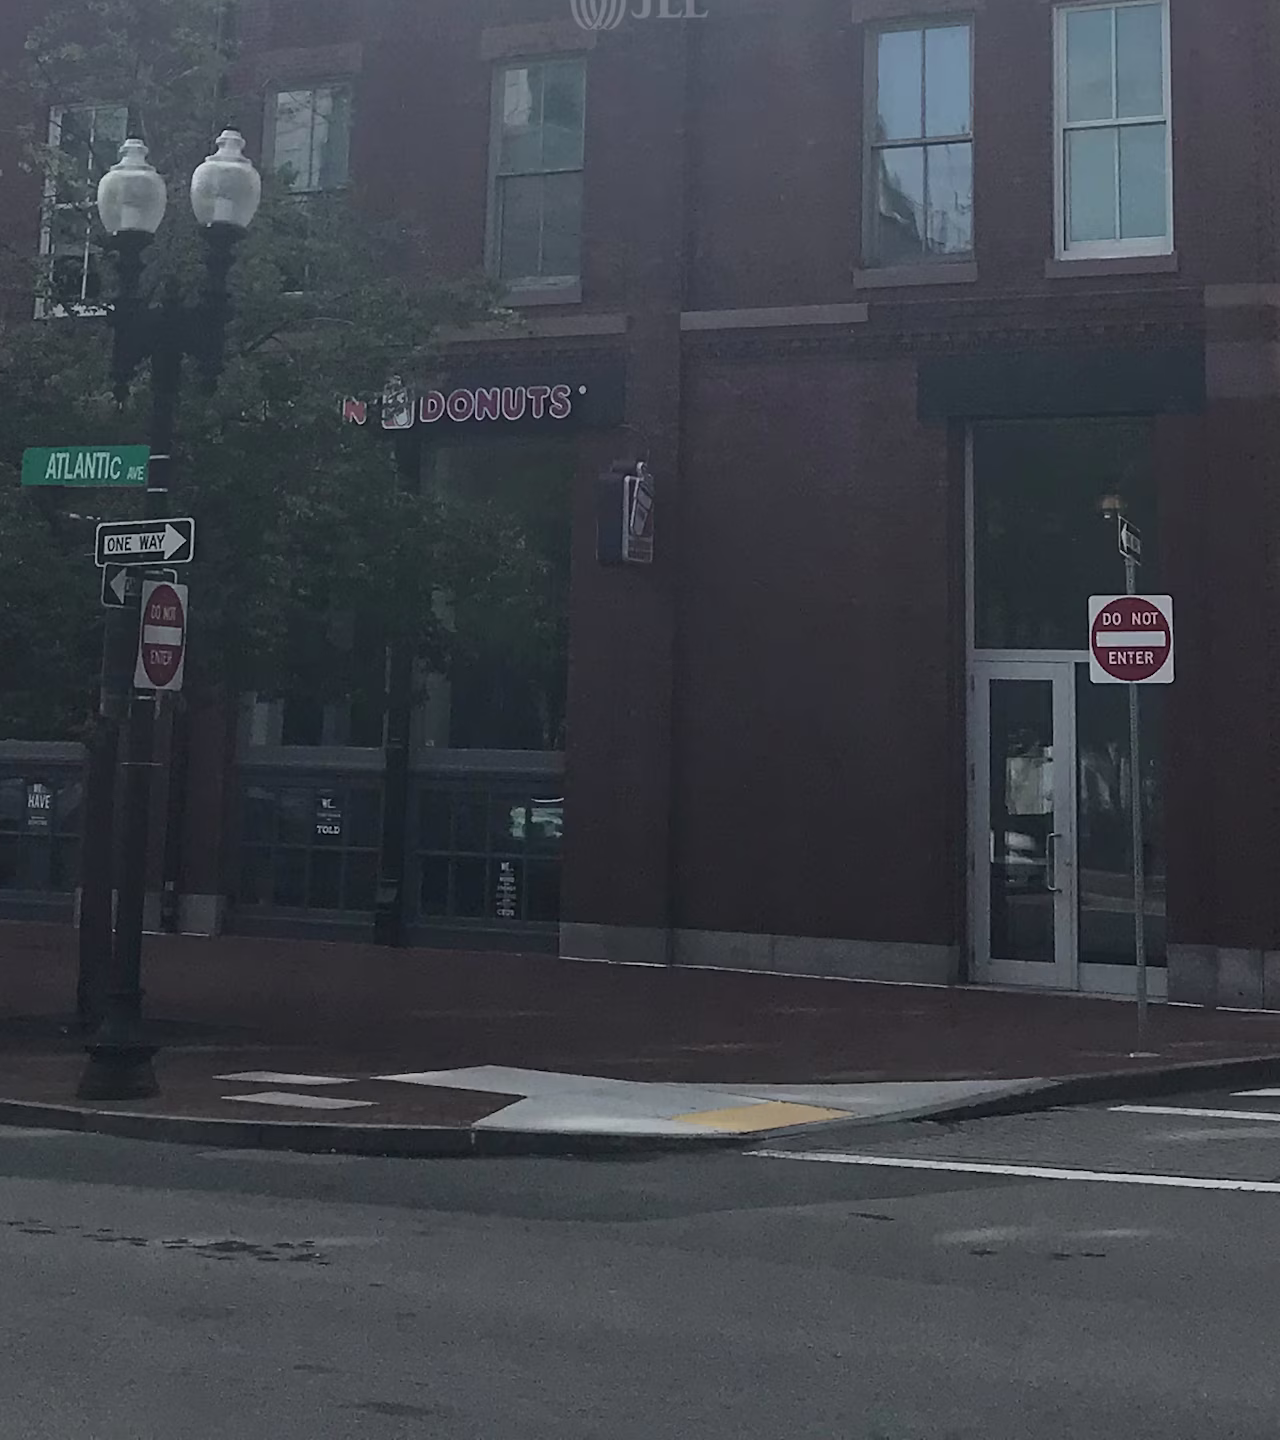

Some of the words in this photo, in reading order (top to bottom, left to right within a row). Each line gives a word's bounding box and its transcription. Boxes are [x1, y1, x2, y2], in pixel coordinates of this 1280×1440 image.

[420, 385, 571, 423] DONUTS
[45, 452, 122, 480] ATLANTIC
[126, 466, 144, 481] AVE
[107, 536, 132, 552] ONE
[140, 534, 165, 550] WAY
[151, 604, 161, 620] DO
[163, 606, 176, 620] NOT
[1102, 612, 1122, 626] DO
[1131, 612, 1158, 626] NOT
[150, 650, 172, 665] ENTER
[1108, 651, 1154, 665] ENTER
[28, 794, 51, 809] HAVE
[316, 825, 341, 835] TOLD
